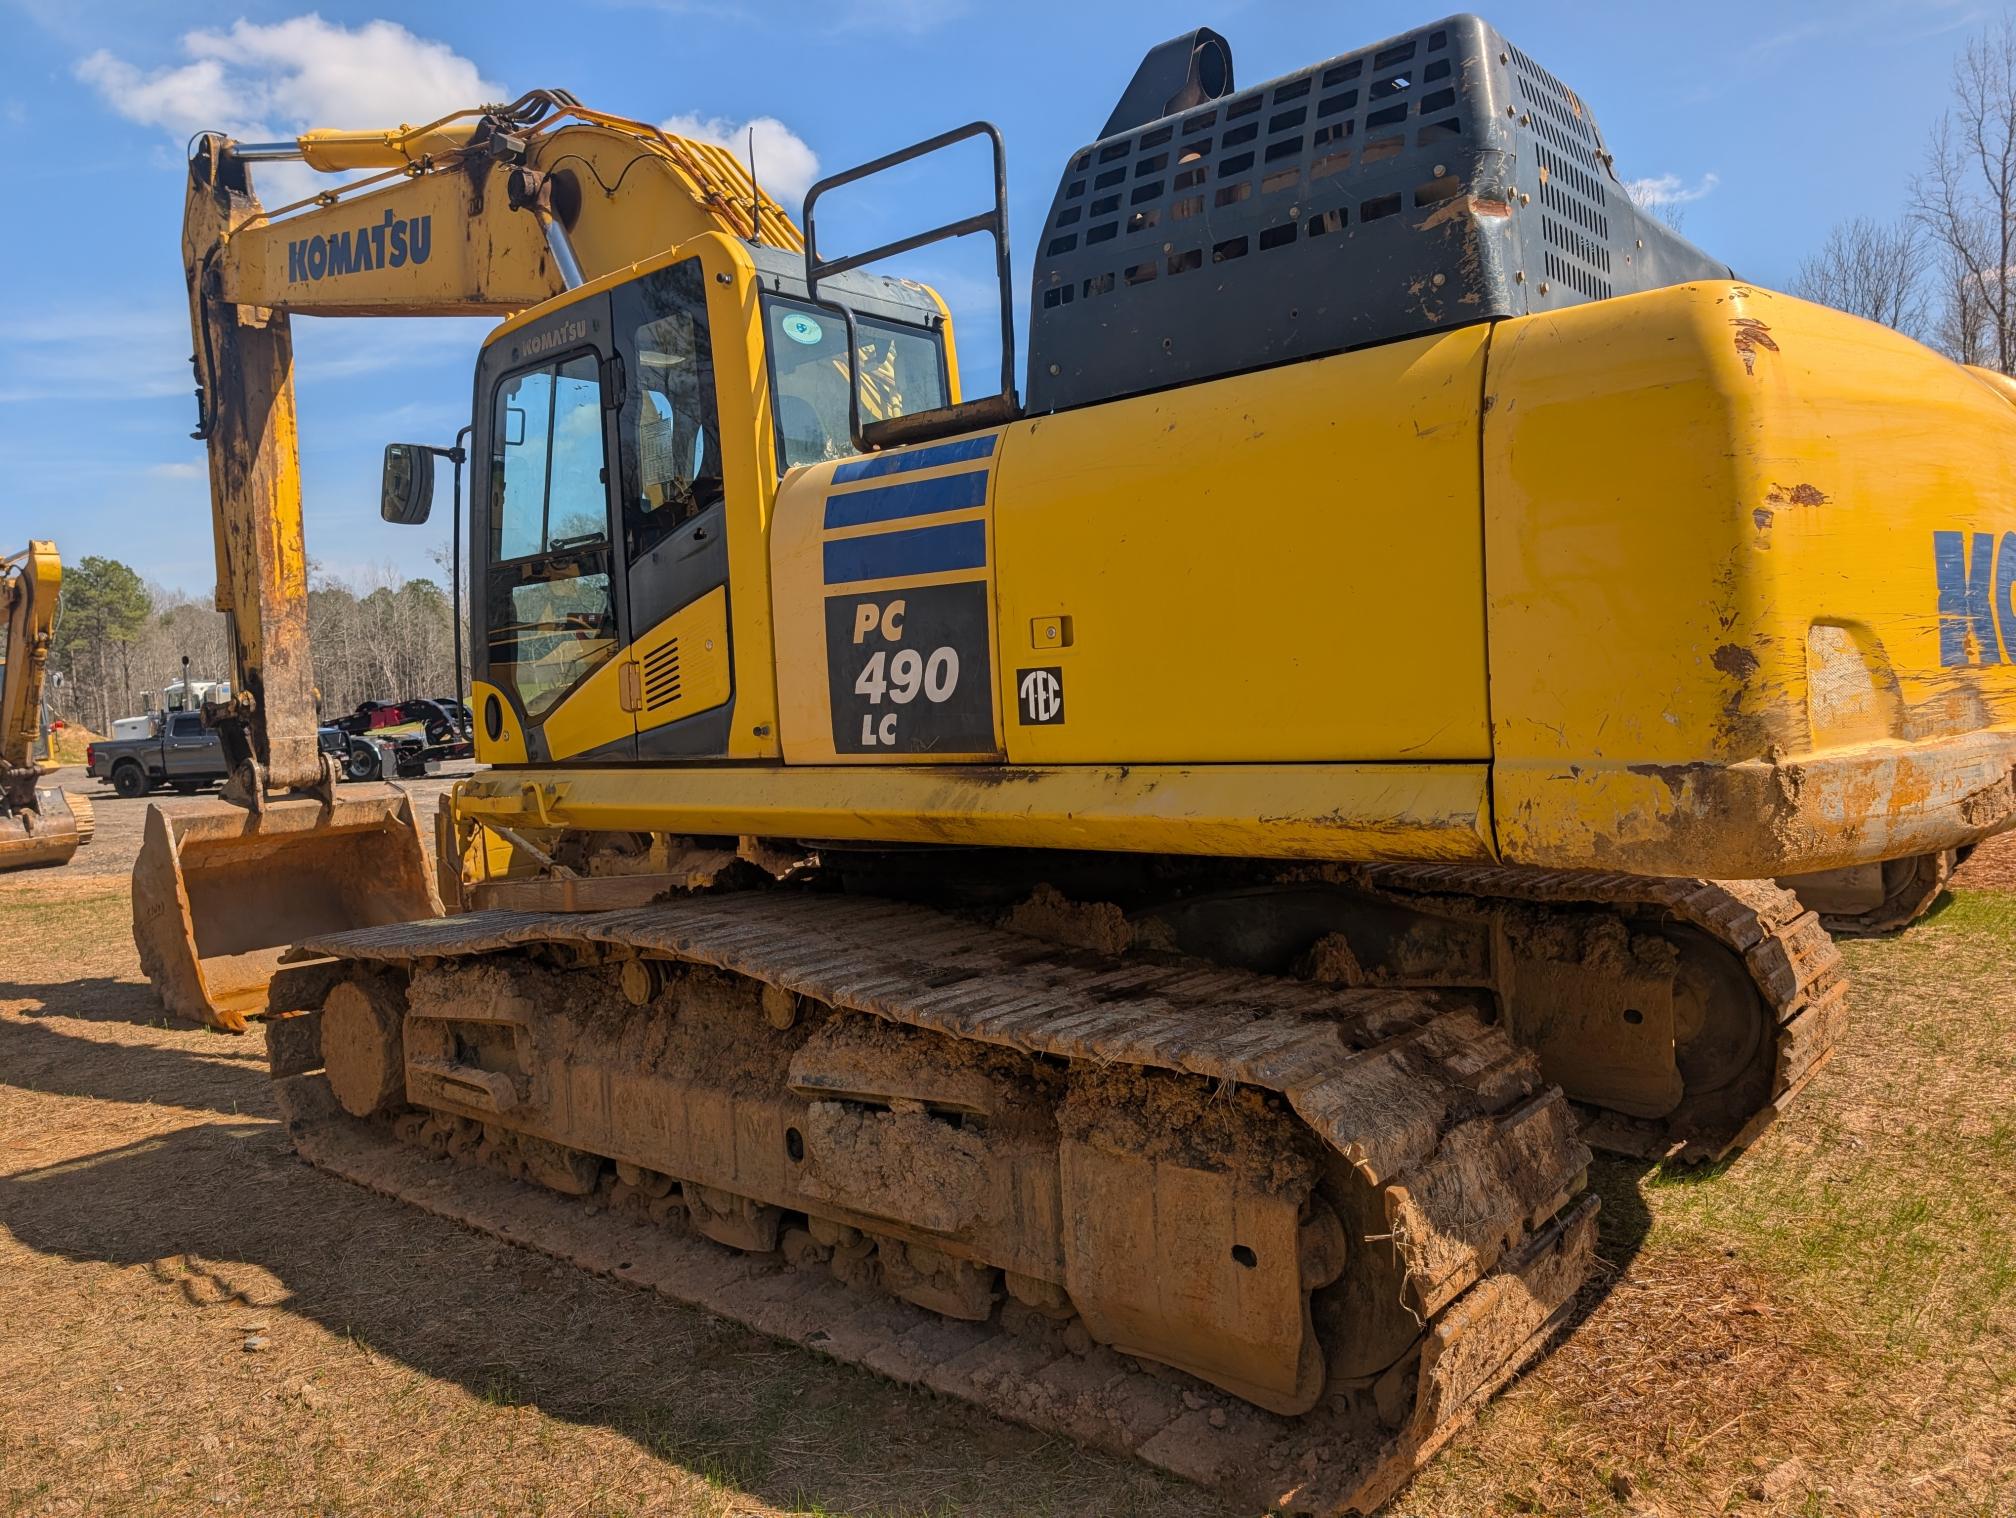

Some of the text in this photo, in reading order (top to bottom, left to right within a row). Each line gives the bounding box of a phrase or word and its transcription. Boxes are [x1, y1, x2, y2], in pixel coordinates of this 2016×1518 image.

[288, 208, 431, 283] KOMATSU
[521, 320, 586, 357] KOMATSU
[853, 600, 906, 644] PC
[855, 646, 960, 704] 490
[861, 713, 898, 746] LC
